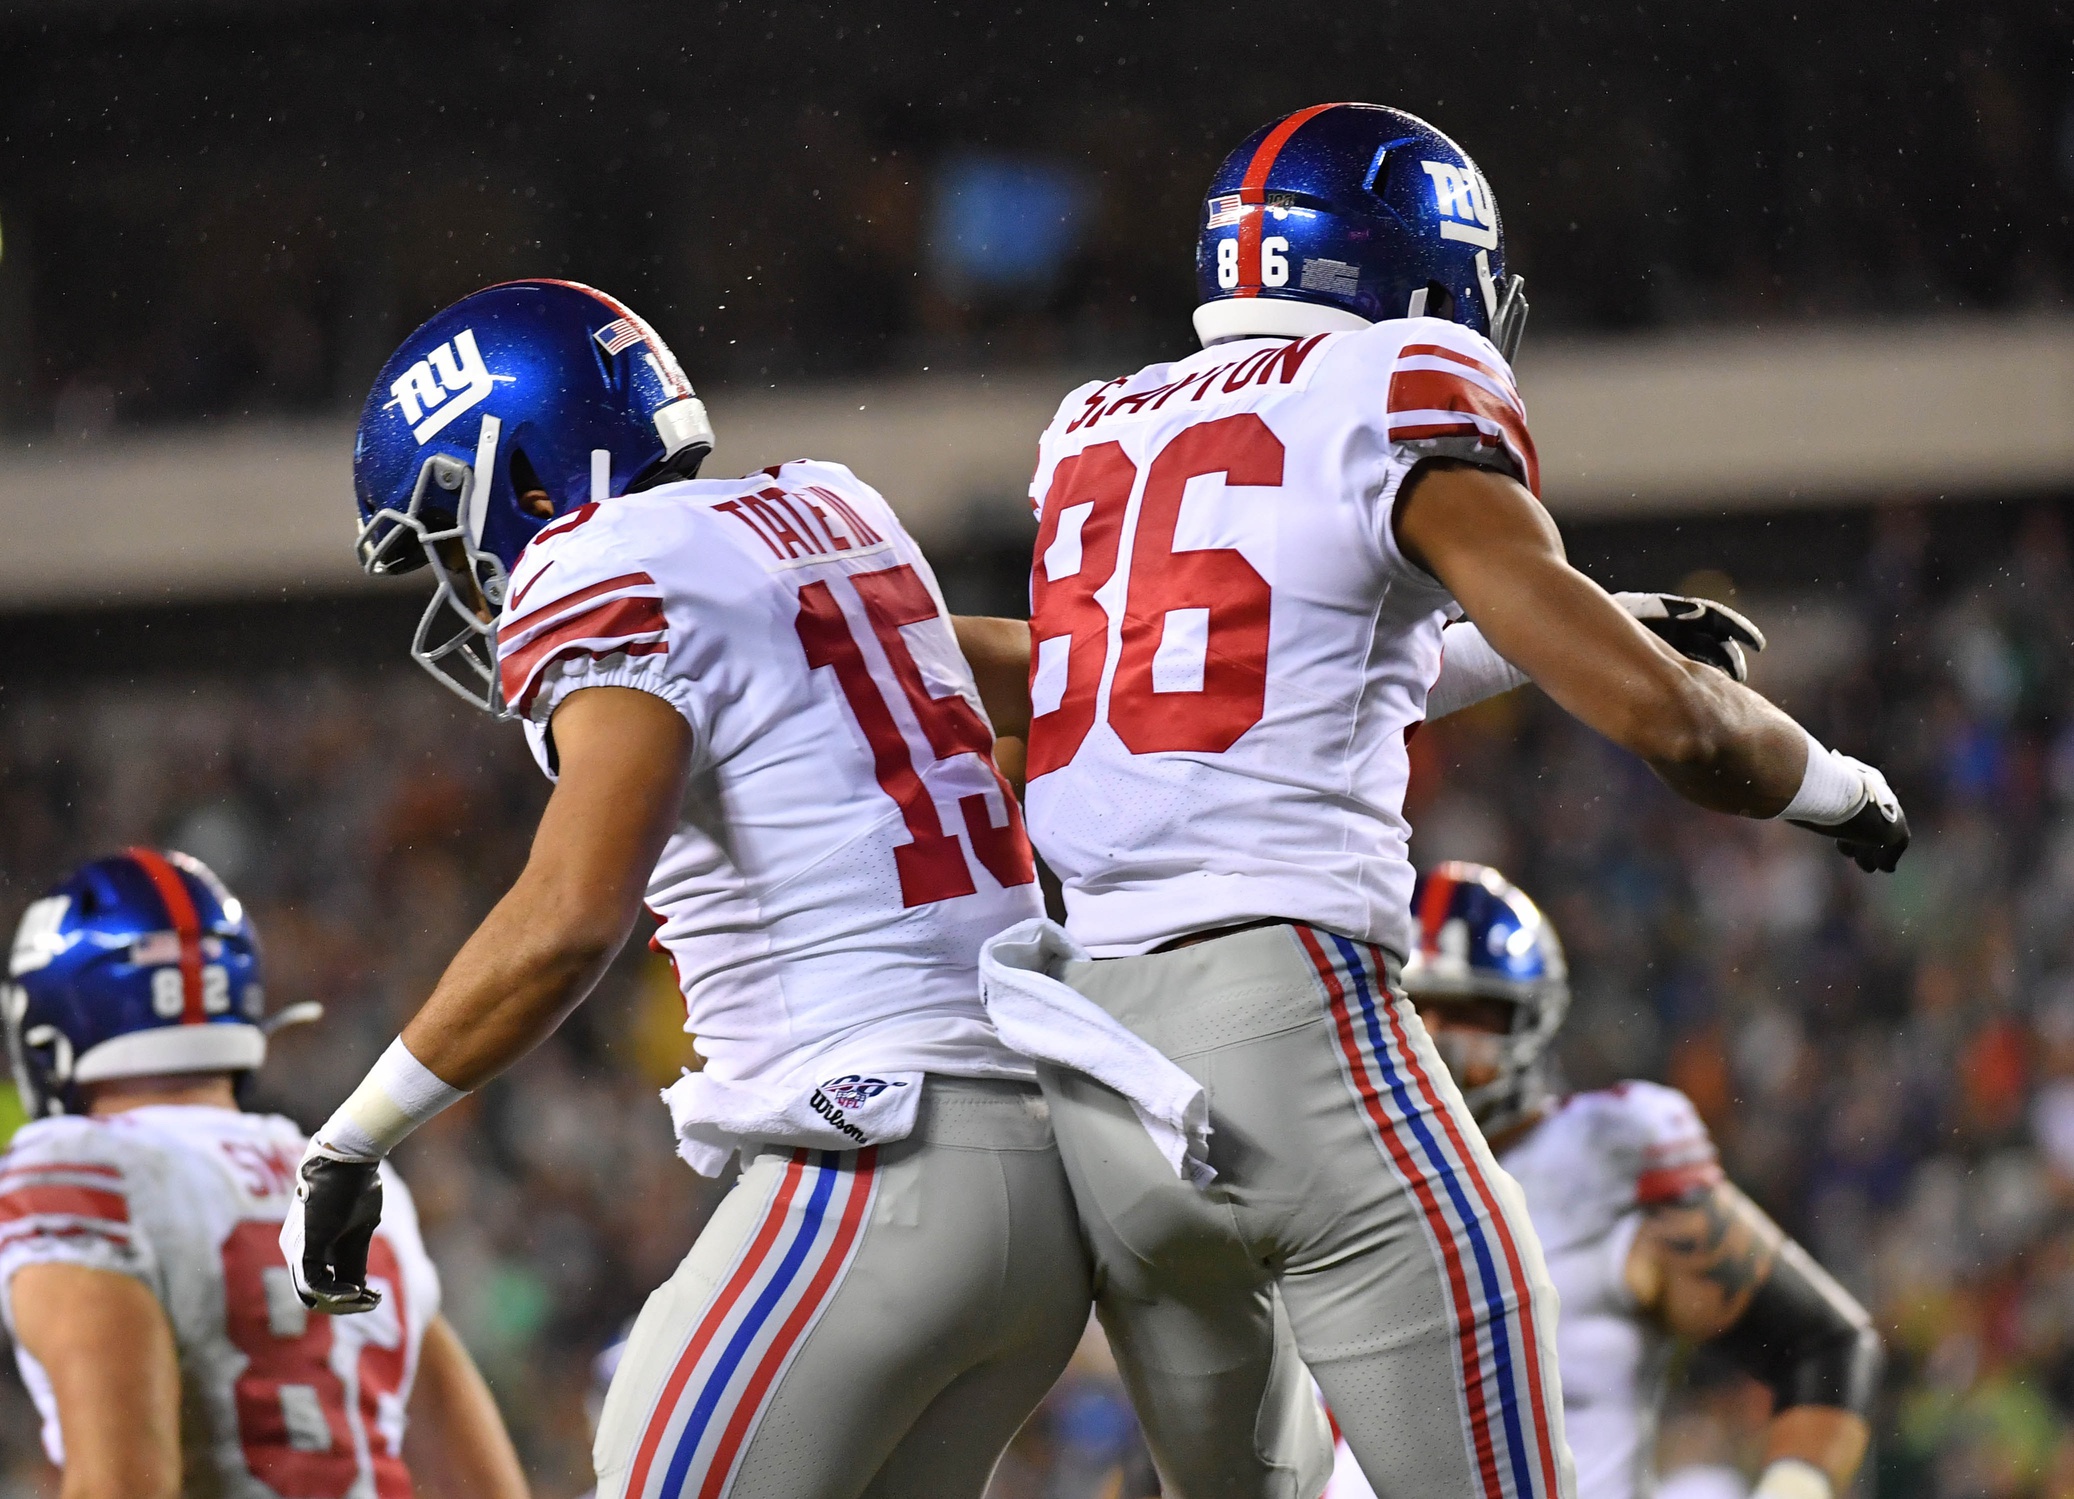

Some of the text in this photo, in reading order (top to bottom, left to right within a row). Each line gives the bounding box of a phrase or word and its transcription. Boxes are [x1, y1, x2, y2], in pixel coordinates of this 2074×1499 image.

[710, 487, 851, 560] TATE
[1026, 412, 1286, 783] 86
[794, 563, 1034, 908] 15
[809, 1088, 868, 1144] Wilson
[837, 1096, 860, 1109] NFL
